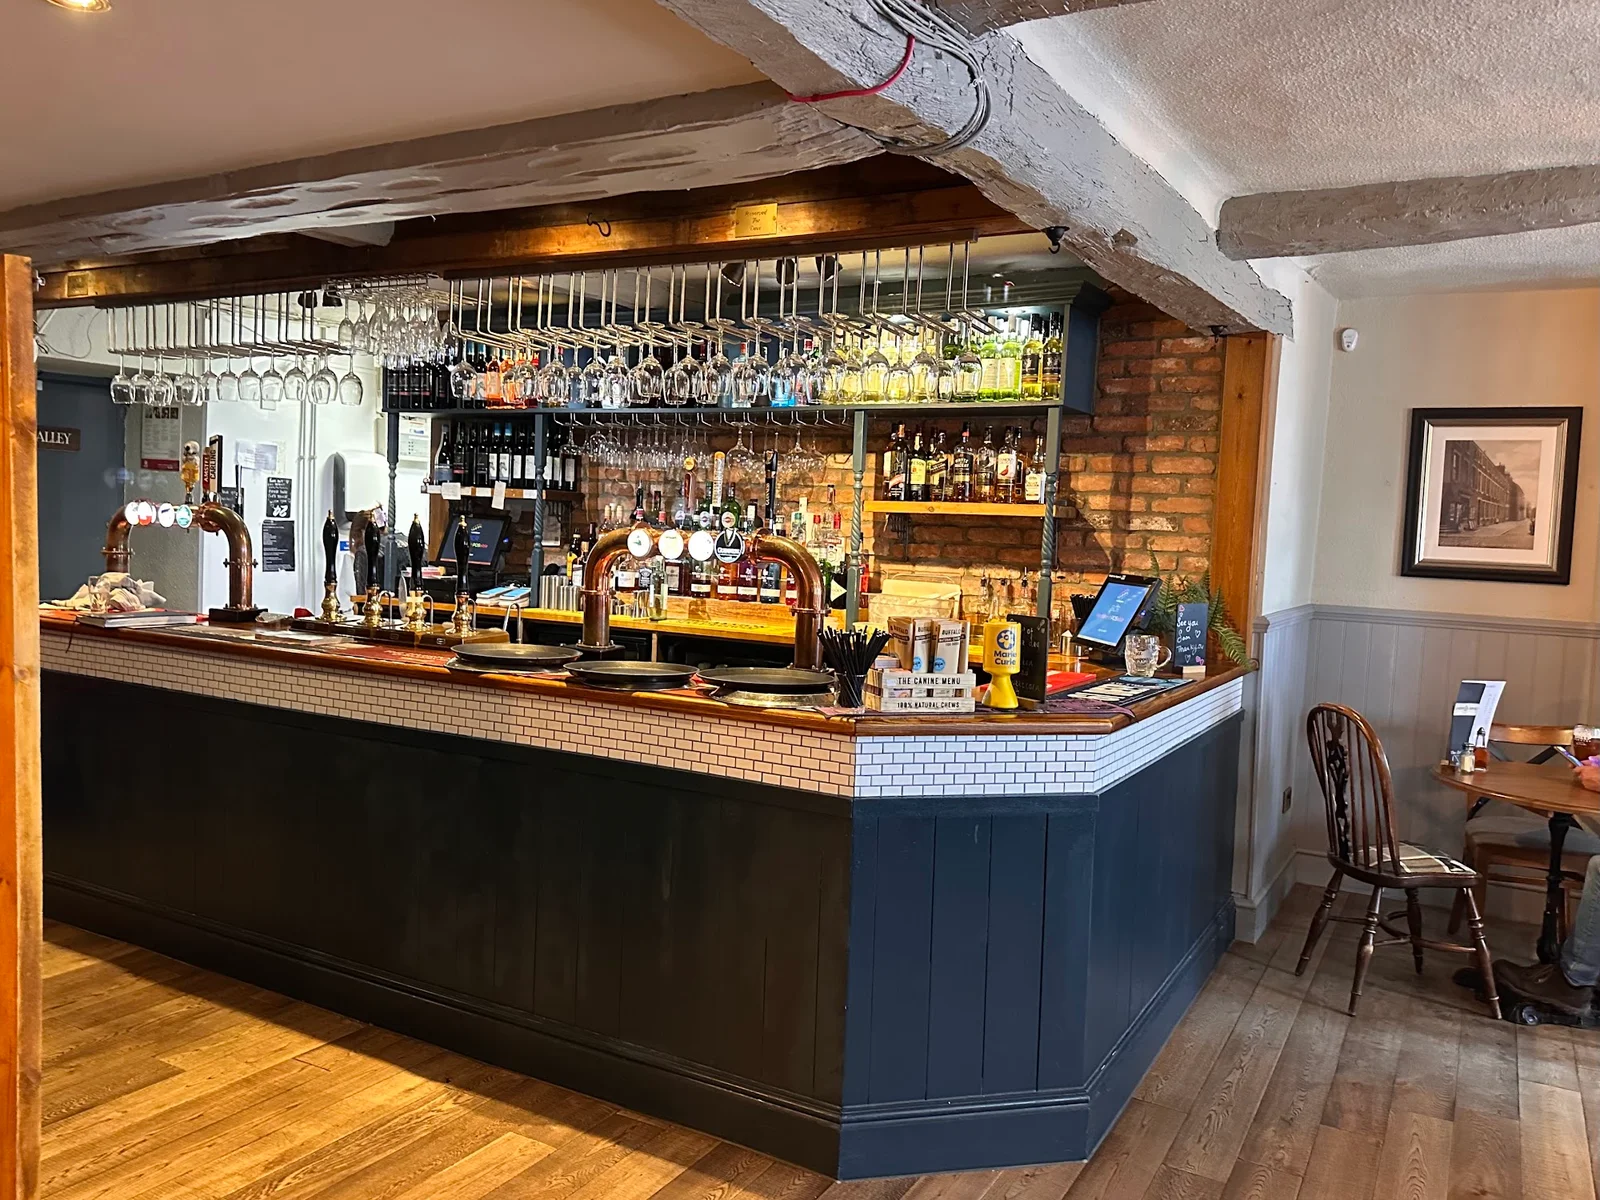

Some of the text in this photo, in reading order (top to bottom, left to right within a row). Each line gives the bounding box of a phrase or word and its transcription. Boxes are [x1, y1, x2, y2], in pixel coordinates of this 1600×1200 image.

[37, 430, 72, 444] ALLEY
[1177, 617, 1198, 632] See you
[993, 650, 1017, 658] Marie
[994, 658, 1016, 666] Curie
